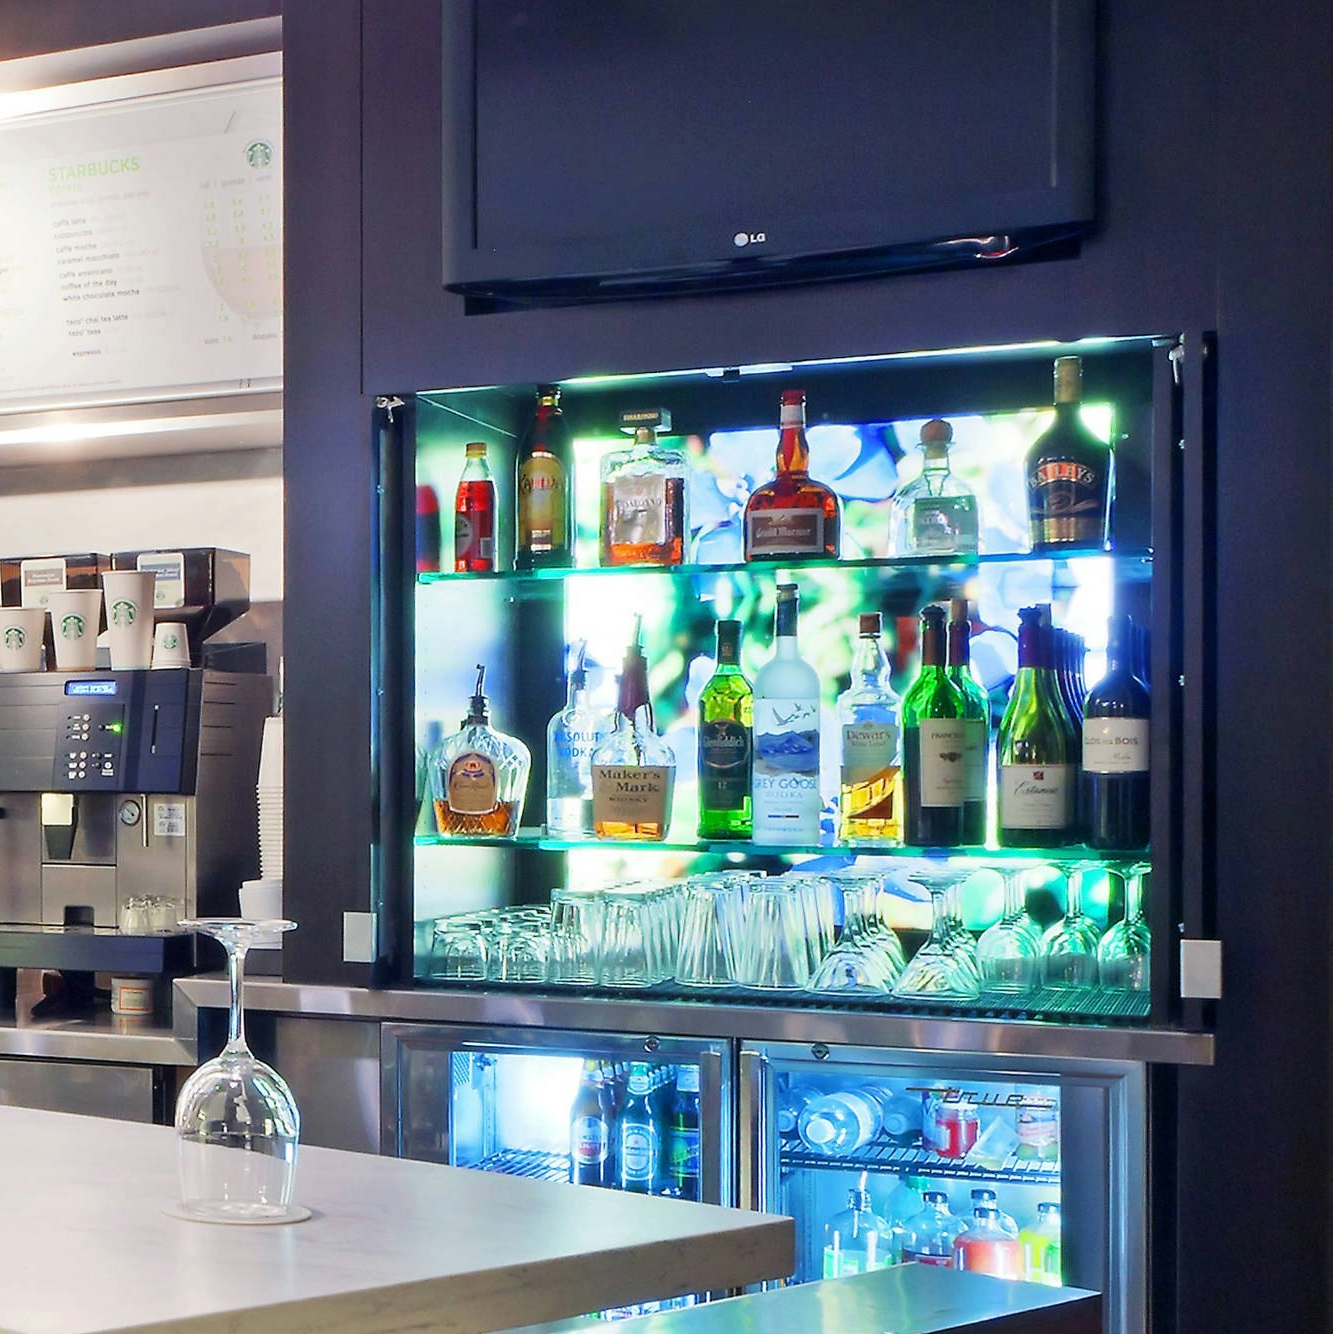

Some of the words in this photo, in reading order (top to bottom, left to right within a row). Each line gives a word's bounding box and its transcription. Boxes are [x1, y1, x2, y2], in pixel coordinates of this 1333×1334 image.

[48, 157, 141, 182] STARBUCKS
[750, 233, 765, 243] LG
[1028, 462, 1095, 488] BAILEYS
[847, 731, 891, 739] Dewar's
[599, 770, 660, 779] Maker's
[616, 783, 659, 792] Mark
